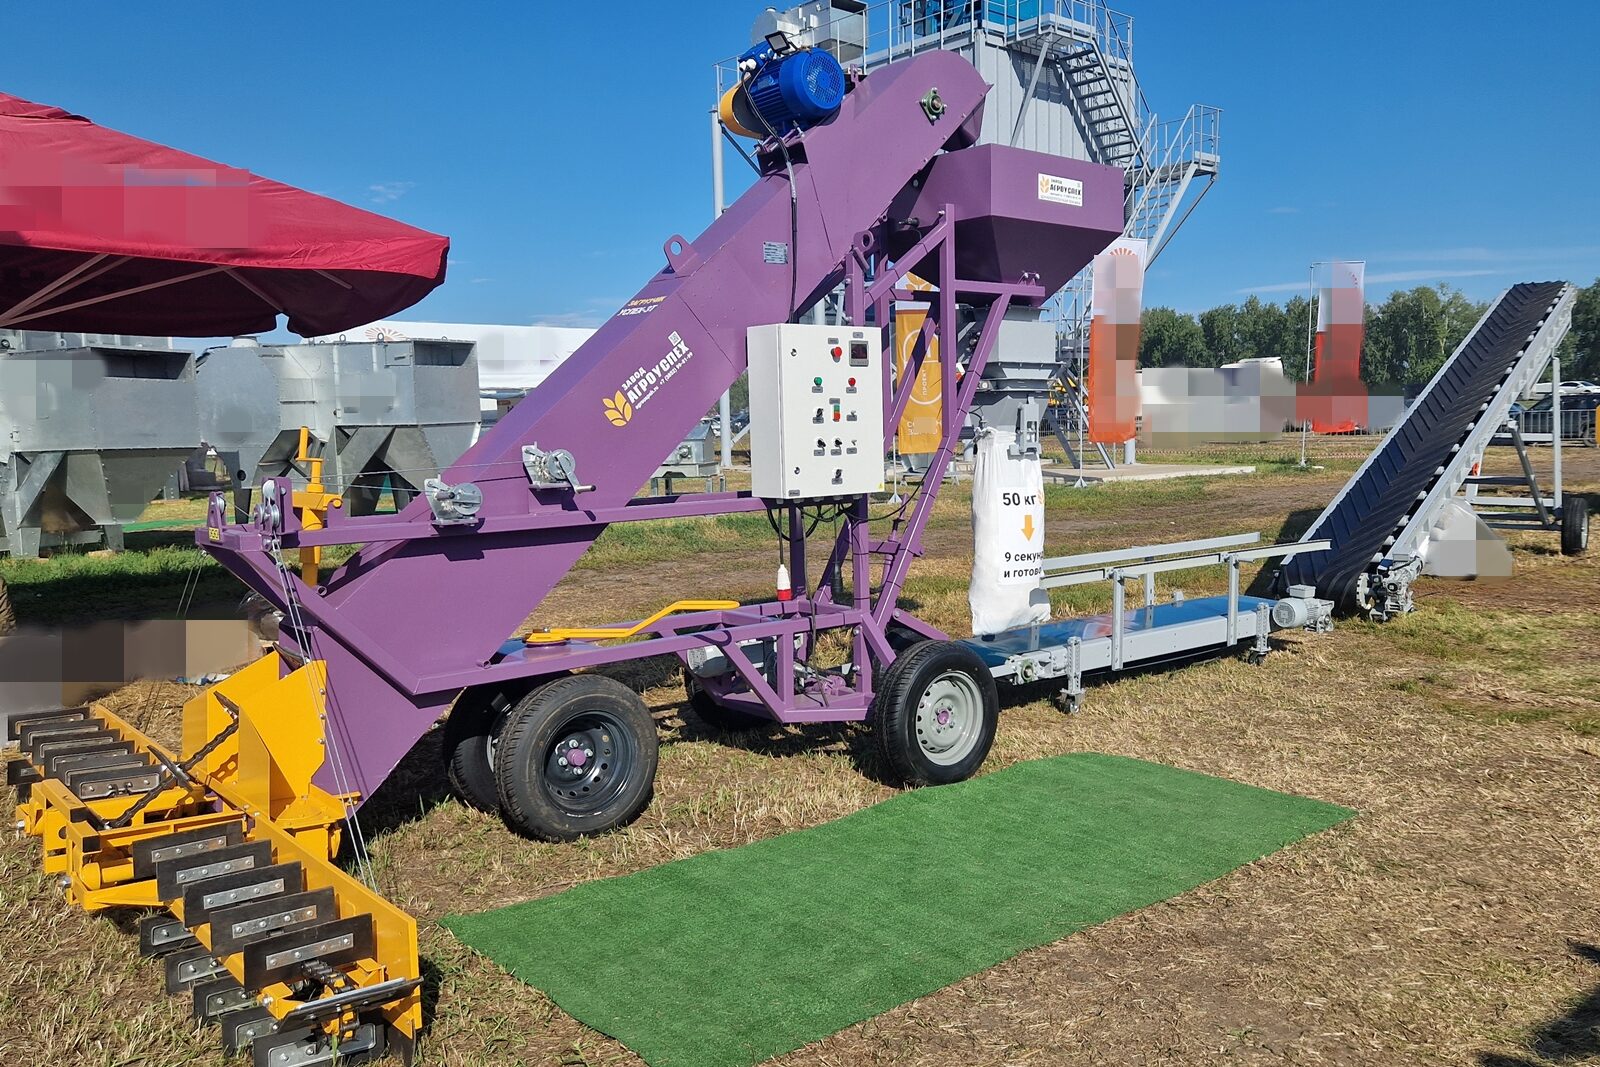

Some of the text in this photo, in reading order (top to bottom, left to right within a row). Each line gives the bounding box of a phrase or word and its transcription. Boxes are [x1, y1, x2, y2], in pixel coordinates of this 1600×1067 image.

[621, 366, 647, 391] ЗАВОД
[626, 340, 690, 404] АГРОУСПЕХ
[1002, 492, 1037, 506] 50 кг
[1004, 551, 1012, 562] 9
[1003, 570, 1010, 578] и
